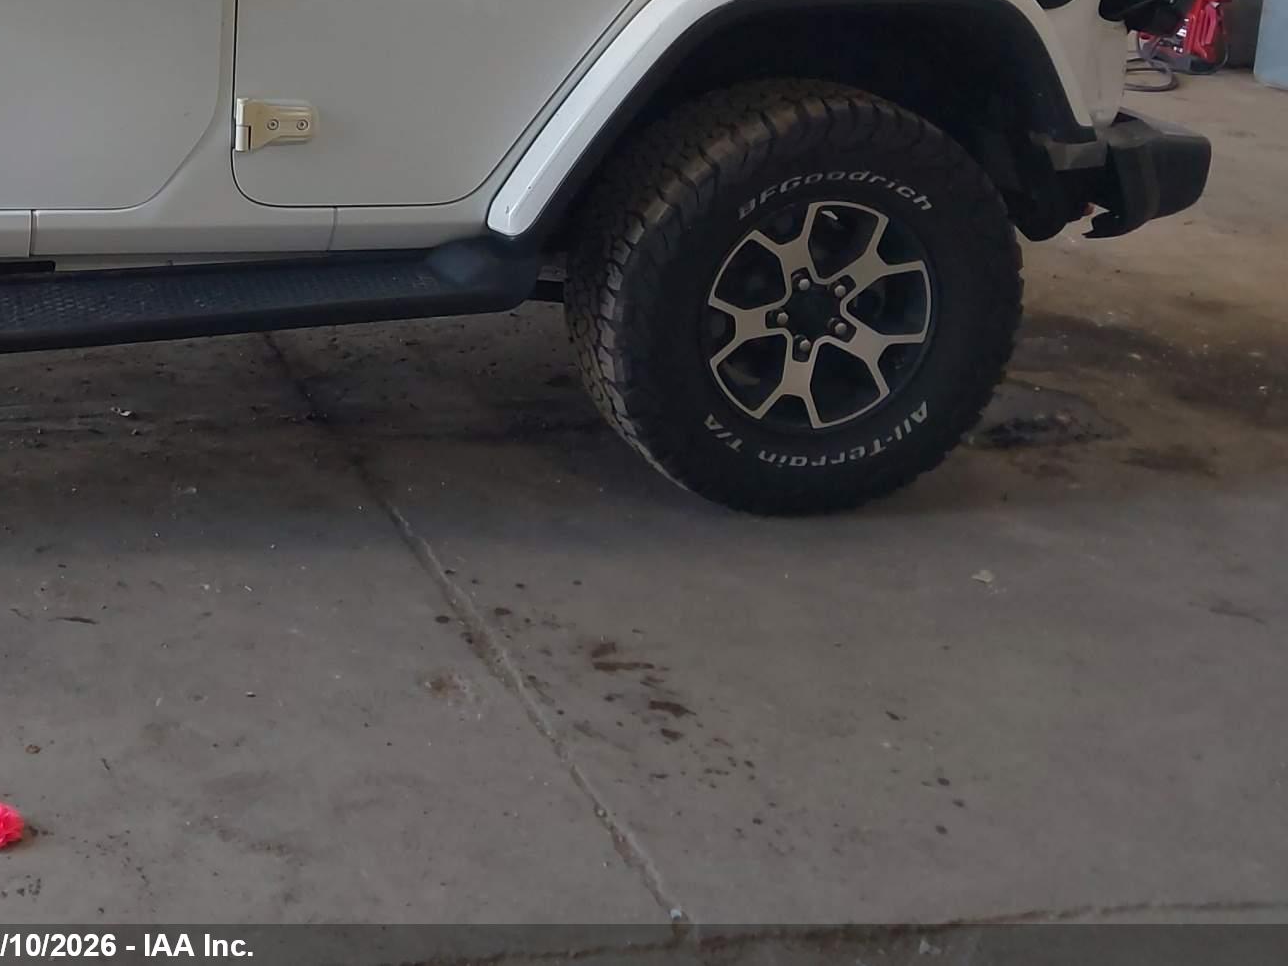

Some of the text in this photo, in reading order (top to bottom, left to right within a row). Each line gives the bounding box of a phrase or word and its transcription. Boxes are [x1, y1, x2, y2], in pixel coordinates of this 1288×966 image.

[738, 170, 933, 221] BFGoodrich
[703, 400, 929, 468] All-Terrain T/A
